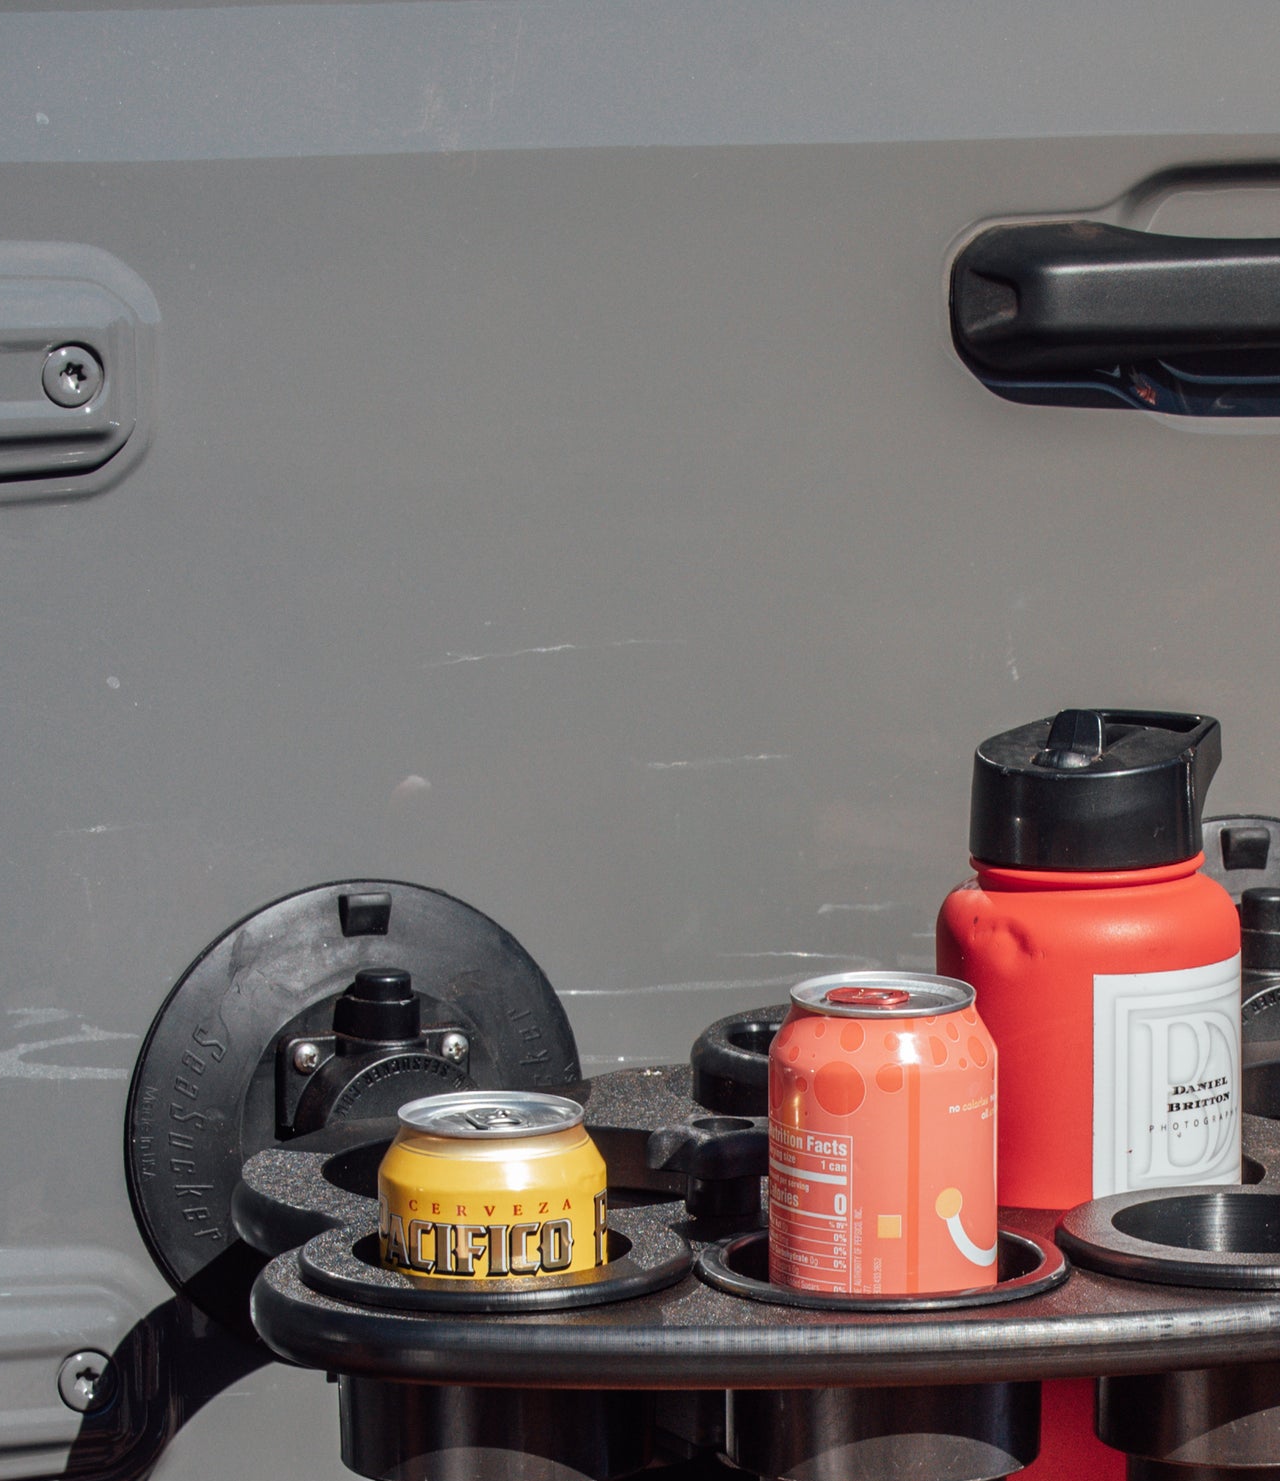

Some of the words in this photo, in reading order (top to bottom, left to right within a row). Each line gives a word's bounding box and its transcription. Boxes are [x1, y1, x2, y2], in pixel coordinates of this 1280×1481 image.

[1173, 1076, 1228, 1096] DANIEL
[949, 1105, 961, 1114] no
[1167, 1091, 1231, 1113] BRITTON
[168, 1023, 227, 1241] SeaSucker
[806, 1135, 847, 1157] Facts
[821, 1160, 826, 1170] 1
[828, 1163, 847, 1173] can
[408, 1198, 572, 1218] CERVEZA
[834, 1193, 847, 1215] 0
[833, 1233, 847, 1243] 0%
[833, 1246, 847, 1256] 0%
[833, 1259, 847, 1269] 0%
